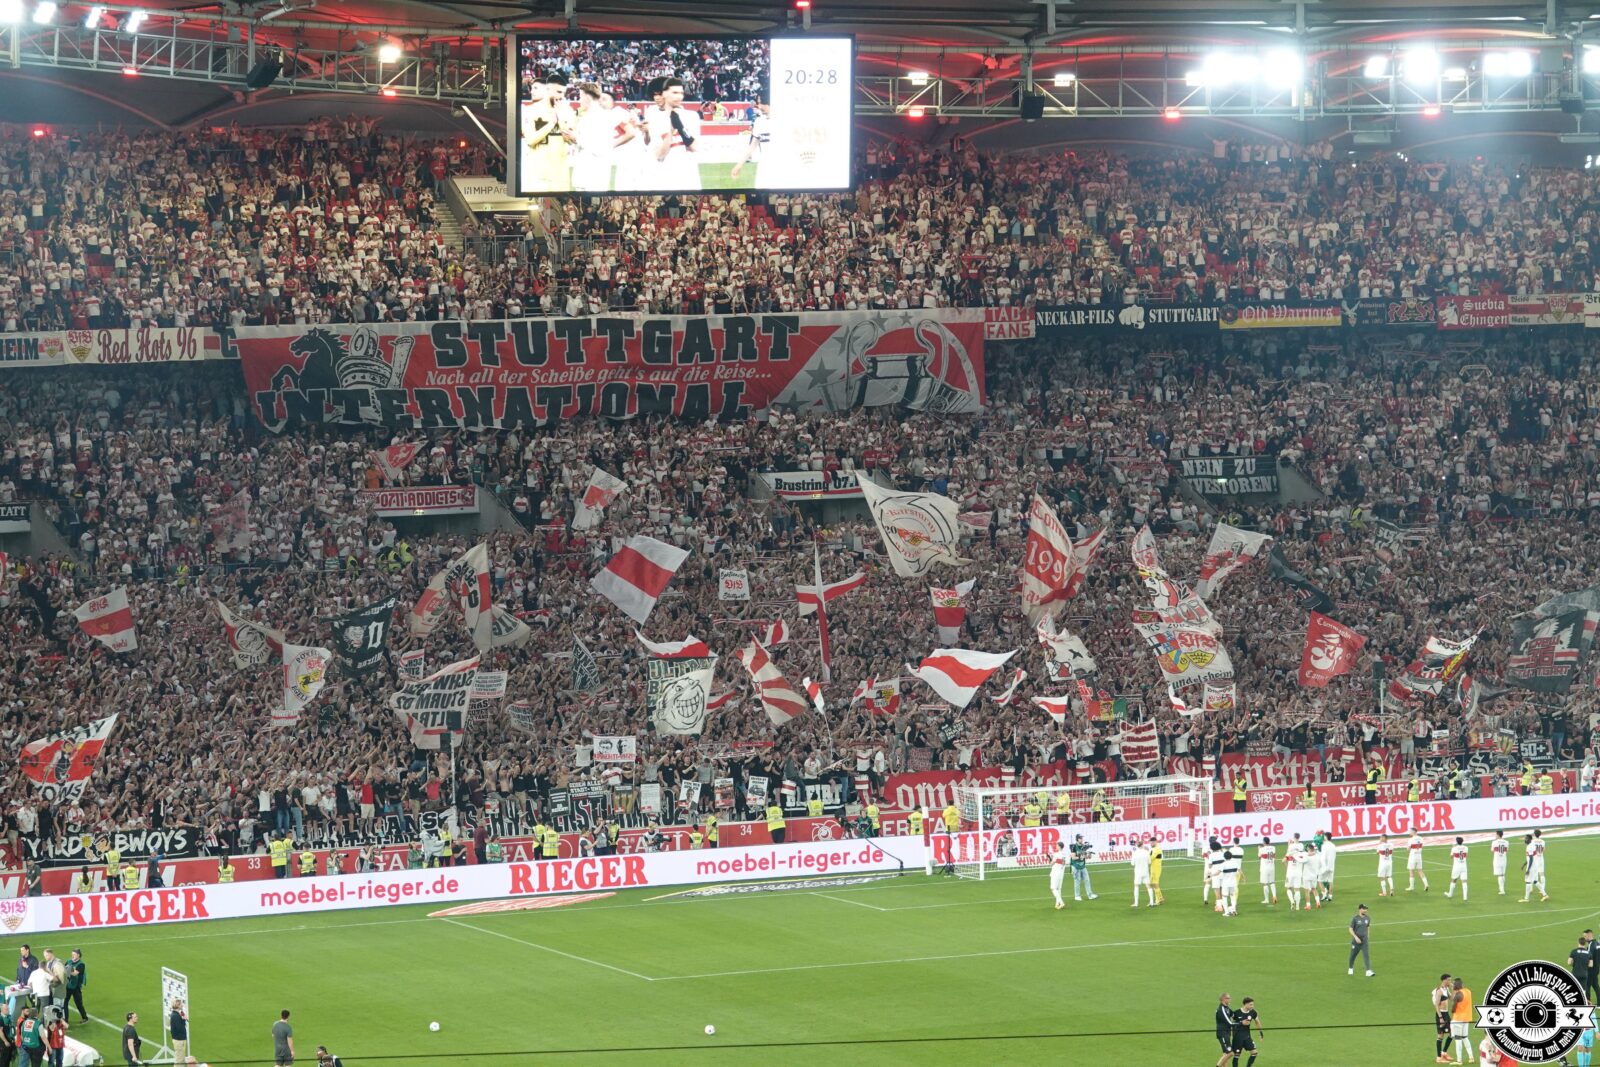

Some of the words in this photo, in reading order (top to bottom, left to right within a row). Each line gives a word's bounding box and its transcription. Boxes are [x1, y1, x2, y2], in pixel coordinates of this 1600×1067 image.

[784, 69, 837, 85] 20:28
[1242, 305, 1268, 323] Old
[1271, 304, 1334, 321] Warriors
[1463, 299, 1505, 312] Suebia
[1036, 309, 1115, 325] NECKAR-FILS
[1149, 306, 1219, 323] STUTTGART
[1460, 313, 1509, 326] Ehingen
[986, 322, 1030, 337] FANS
[98, 329, 131, 363] Red
[137, 327, 172, 362] Hots
[177, 327, 196, 360] 96
[430, 315, 800, 367] STUTTGART
[425, 369, 466, 385] Nach
[469, 367, 493, 384] all
[498, 369, 525, 385] der
[530, 366, 593, 384] Scheiße
[597, 366, 645, 384] geht's
[650, 366, 681, 382] auf
[687, 366, 708, 381] die
[1182, 459, 1224, 476] NEIN
[1234, 458, 1256, 475] ZU
[775, 478, 829, 492] Brustring
[407, 490, 456, 506] ADDICTS
[1167, 797, 1179, 808] 35
[1330, 802, 1455, 837] RIEGER
[740, 824, 752, 836] 34
[1108, 817, 1285, 848] moebel-rieger.de
[114, 828, 188, 853] BWOYS
[247, 857, 261, 869] 33
[697, 845, 884, 875] moebel-rieger.de
[509, 855, 648, 895] RIEGER
[261, 875, 459, 907] moebel-rieger.de
[59, 887, 209, 928] RIEGER
